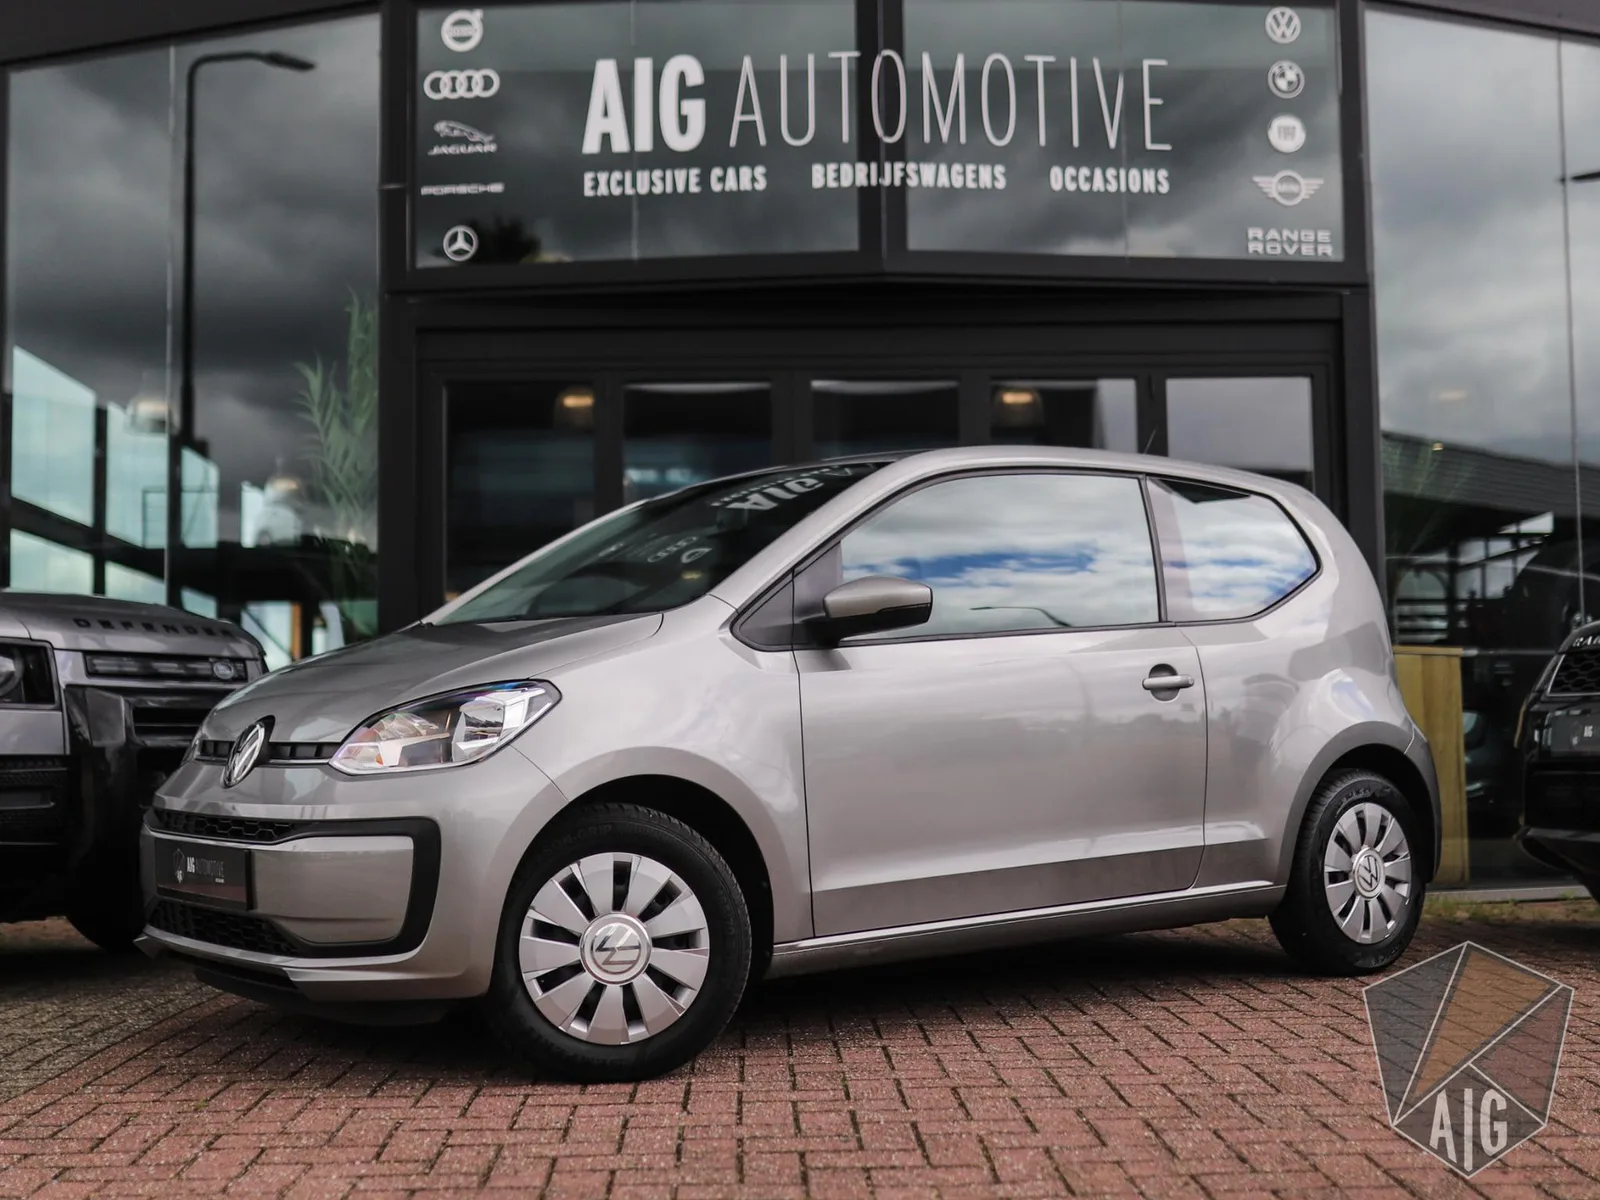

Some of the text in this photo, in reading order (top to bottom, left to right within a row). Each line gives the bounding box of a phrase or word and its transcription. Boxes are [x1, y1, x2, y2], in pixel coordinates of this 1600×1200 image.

[582, 49, 1172, 154] AIG AUTOMOTIVE
[583, 162, 1170, 197] EXCLUSIVE CARS BEDRIJFSWAGENS OCCASIONS
[420, 182, 505, 197] PORSCHE
[1246, 227, 1332, 243] RANGE
[1247, 242, 1333, 257] ROVER
[73, 618, 235, 638] DEFENDER
